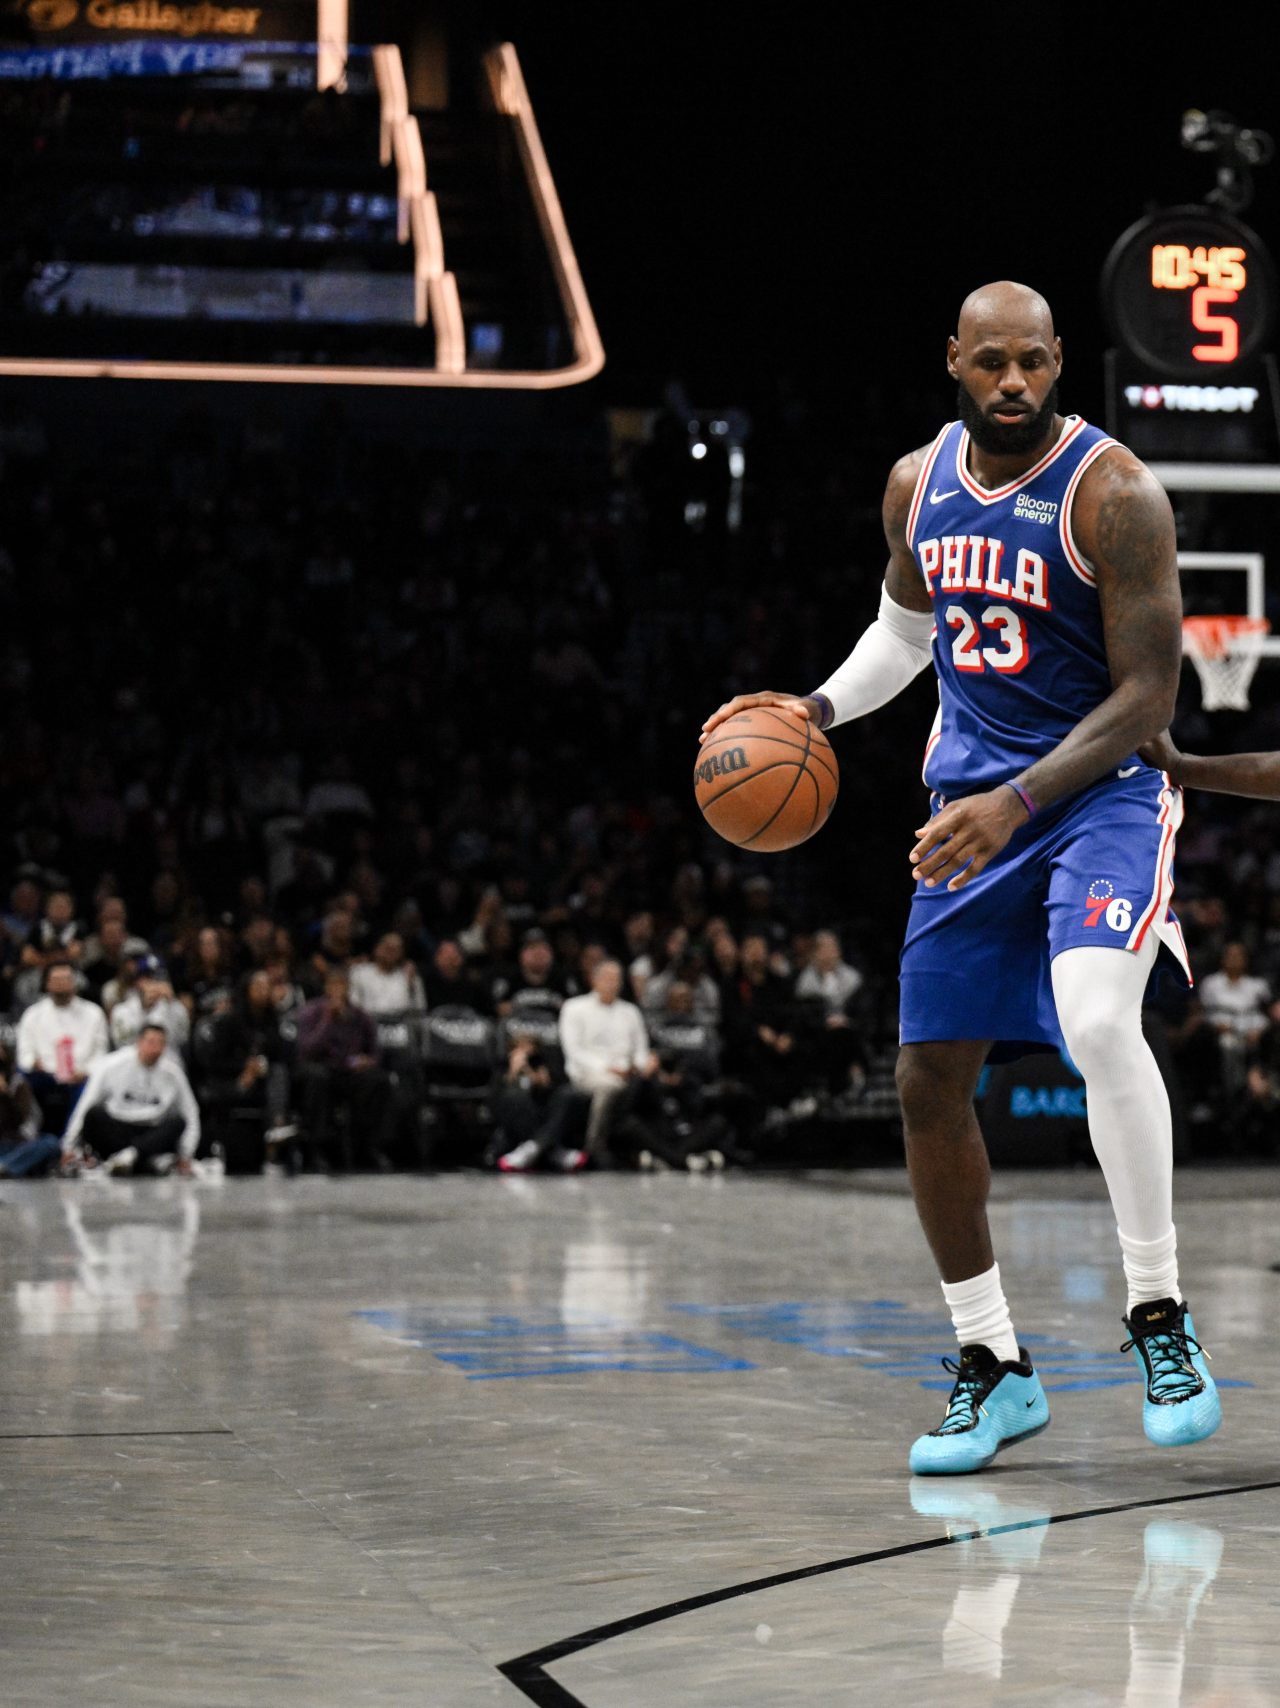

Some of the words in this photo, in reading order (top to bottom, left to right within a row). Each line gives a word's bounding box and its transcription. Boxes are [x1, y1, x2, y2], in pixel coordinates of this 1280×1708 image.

[1191, 286, 1239, 362] 5
[1013, 505, 1055, 525] energy
[1016, 493, 1058, 513] Bloom
[918, 535, 1052, 611] PHILA
[945, 605, 1030, 674] 23
[1083, 896, 1133, 932] 76
